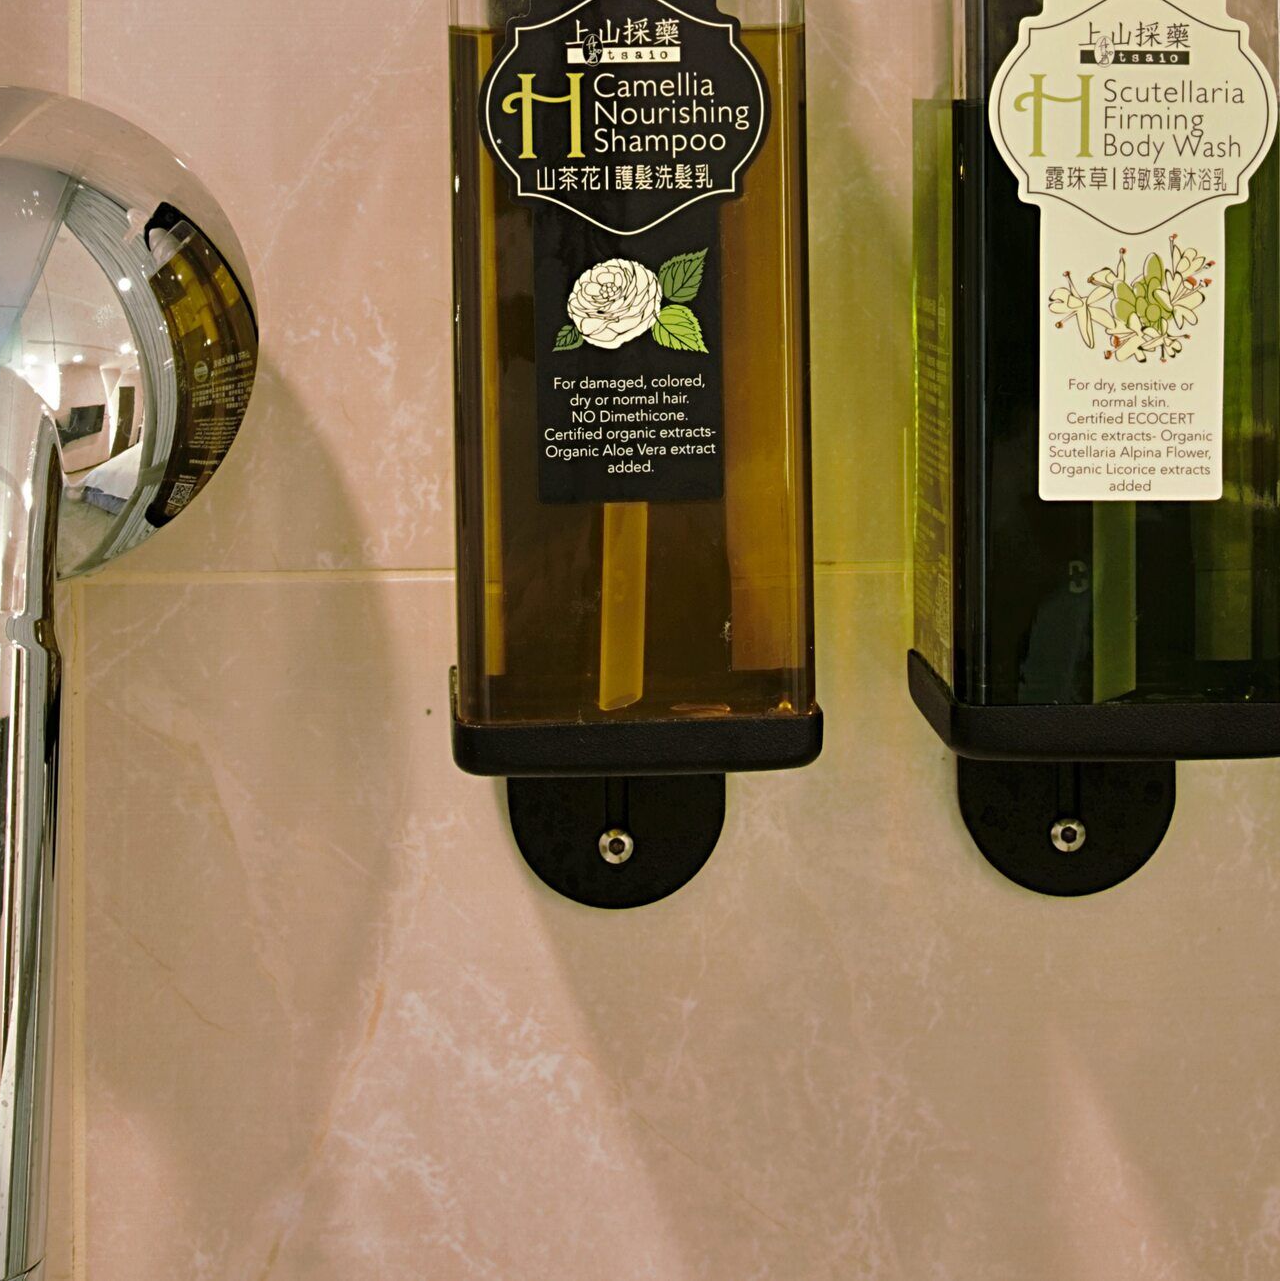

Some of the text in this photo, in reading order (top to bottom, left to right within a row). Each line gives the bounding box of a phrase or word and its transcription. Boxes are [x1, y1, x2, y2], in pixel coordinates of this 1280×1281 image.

[565, 18, 682, 46] 上山採藥
[1078, 21, 1191, 49] 上山採藥
[593, 72, 714, 98] Camellia
[1104, 79, 1245, 104] Scutellaria
[595, 99, 750, 130] Nourishing
[1104, 106, 1204, 137] Firming
[594, 128, 726, 158] Shampoo
[1104, 133, 1241, 163] Body Wash
[554, 374, 705, 391] For damaged, colored,
[1069, 379, 1194, 394] For dry, sensitive or
[570, 391, 689, 409] dry or normal hair.
[1092, 395, 1169, 407] normal skin.
[572, 409, 688, 423] NO Dimethicone.
[1067, 412, 1195, 424] Certified ECOCERT
[545, 427, 602, 441] Certified
[606, 427, 655, 443] organic
[1048, 431, 1097, 444] organic
[1161, 429, 1212, 444] Organic
[545, 443, 716, 460] Organic Aloe Vera extract
[1049, 446, 1211, 460] Scutellaria Alpina Flower,
[608, 460, 654, 473] added.
[1050, 462, 1210, 478] Organic Licorice extracts
[1109, 480, 1152, 492] added
